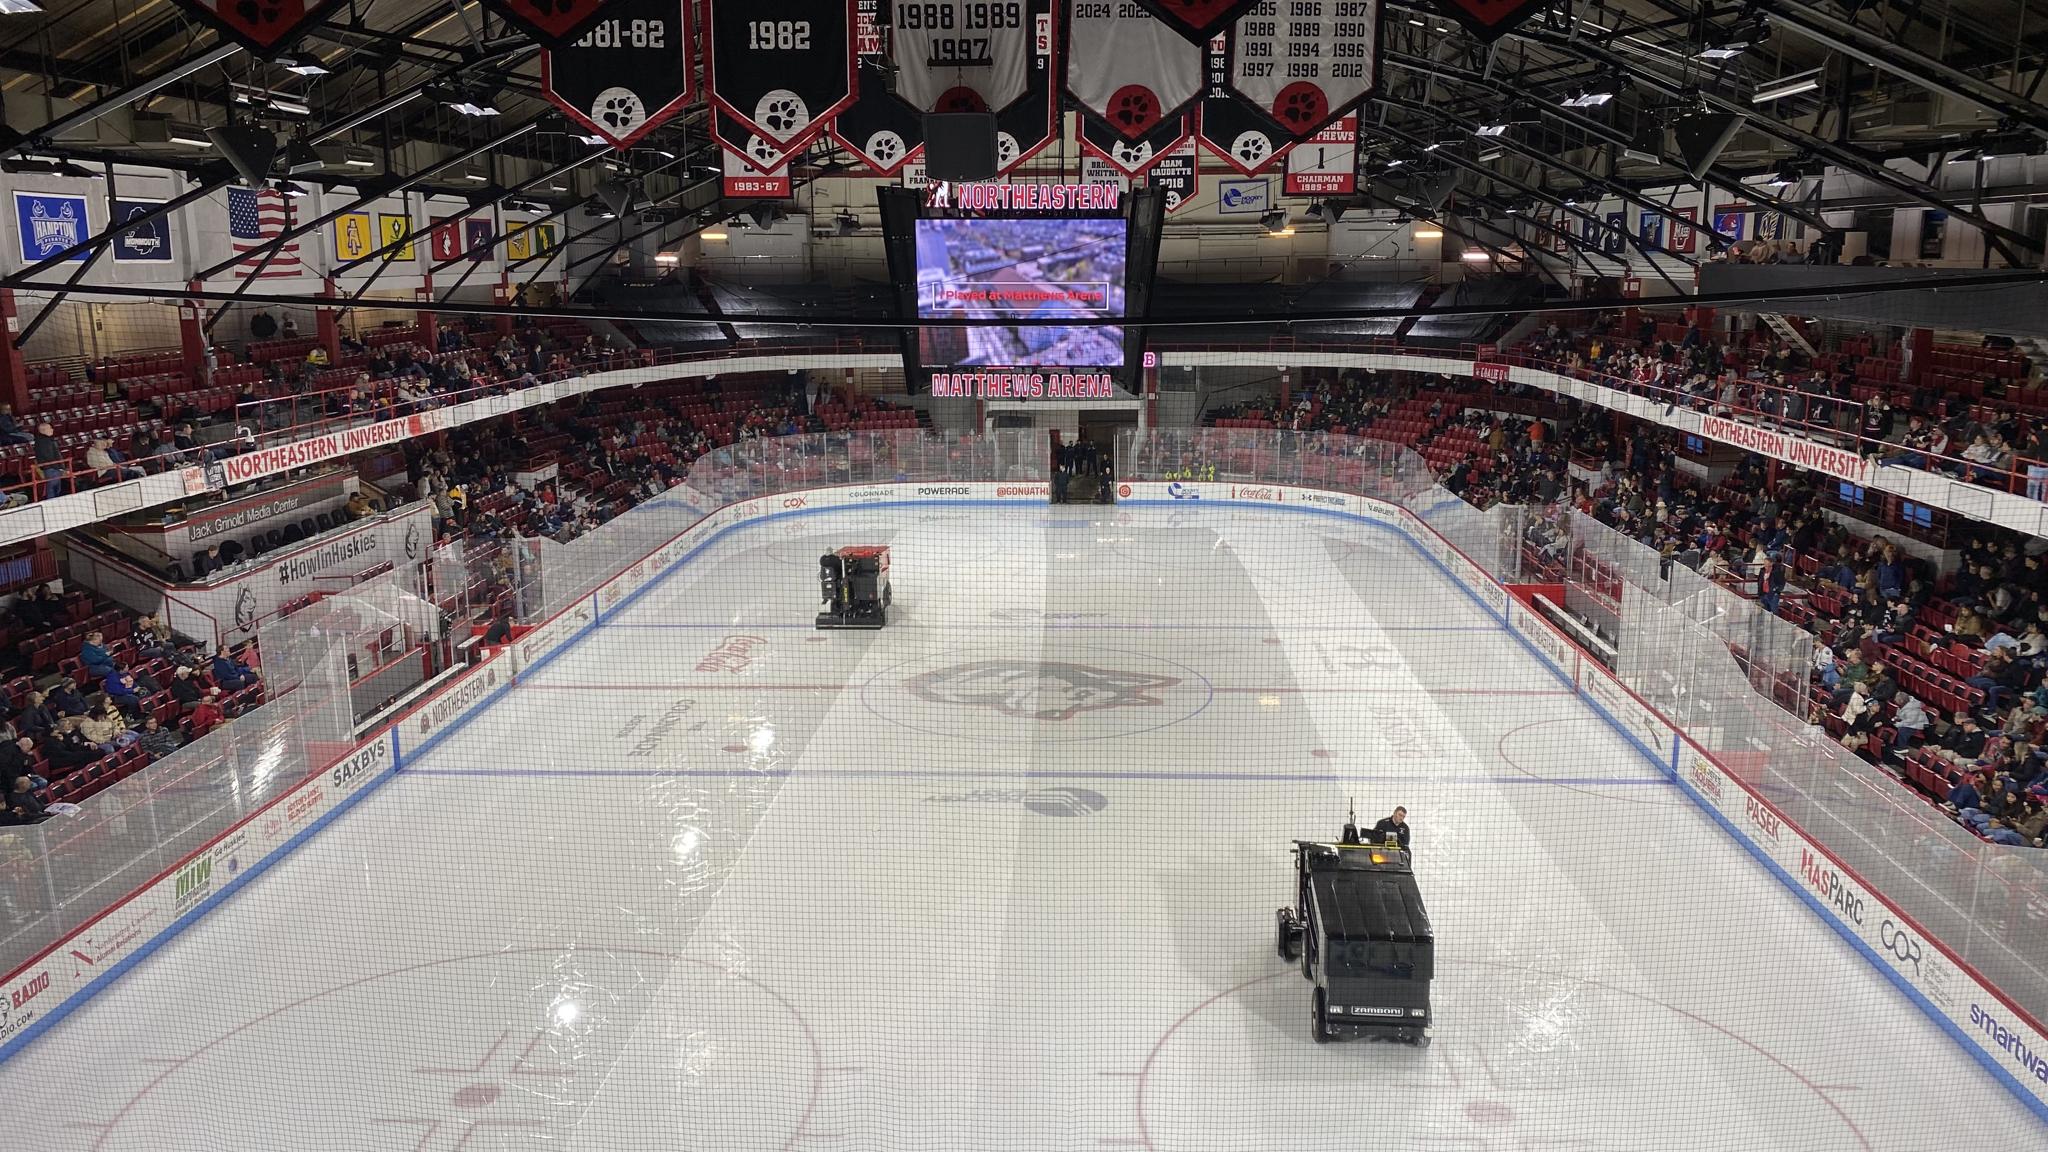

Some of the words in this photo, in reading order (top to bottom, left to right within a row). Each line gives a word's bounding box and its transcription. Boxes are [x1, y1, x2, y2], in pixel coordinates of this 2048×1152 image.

[899, 3, 954, 29] 1988
[965, 3, 1020, 29] 1989
[1076, 4, 1111, 18] 2024
[1290, 2, 1321, 17] 1986
[1335, 2, 1367, 17] 1987
[571, 19, 664, 48] 81-82
[749, 21, 811, 50] 1982
[1244, 22, 1275, 36] 1988
[1288, 22, 1320, 37] 1989
[1333, 22, 1365, 37] 1990
[932, 38, 988, 60] 1997
[1245, 43, 1273, 57] 1991
[1288, 43, 1320, 57] 1994
[1332, 43, 1364, 57] 1996
[1242, 63, 1274, 77] 1997
[1287, 63, 1318, 77] 1998
[1332, 64, 1363, 77] 2012
[1309, 131, 1355, 141] THEWS
[1160, 160, 1182, 168] ADAM
[1317, 147, 1325, 169] 1
[1151, 168, 1192, 176] GAUDETTE
[1297, 175, 1344, 183] CHAIRMAN
[1160, 178, 1184, 188] 2018
[958, 184, 1118, 209] NORTHEASTERN
[36, 220, 75, 239] HAMPTON
[125, 237, 160, 247] MONMOUTH
[989, 291, 1002, 301] at
[1004, 290, 1064, 301] Matthews
[1067, 291, 1103, 301] Arena
[1143, 352, 1155, 367] B
[932, 373, 1043, 398] MATTHEWS
[1048, 373, 1113, 398] ARENA
[227, 437, 338, 482] NORTHEASTERN
[341, 419, 407, 452] UNIVERSITY
[1703, 416, 1784, 458] NORTHEASTERN
[1789, 440, 1869, 480] UNIVERSITY
[849, 489, 894, 498] COLONNADE
[918, 487, 970, 495] POWERADE
[783, 495, 807, 509] COX
[190, 523, 212, 541] Jack
[214, 512, 245, 533] Grinold
[246, 505, 271, 525] Media
[273, 496, 299, 514] Center
[278, 534, 376, 585] #HowlinHuskies
[432, 674, 486, 727] NORTHEASTERN
[333, 739, 385, 788] SAXBYS
[1746, 795, 1780, 842] PASEK
[1800, 847, 1864, 926] MASPARC
[11, 970, 50, 1010] RADIO
[0, 1010, 33, 1040] DIO.COM
